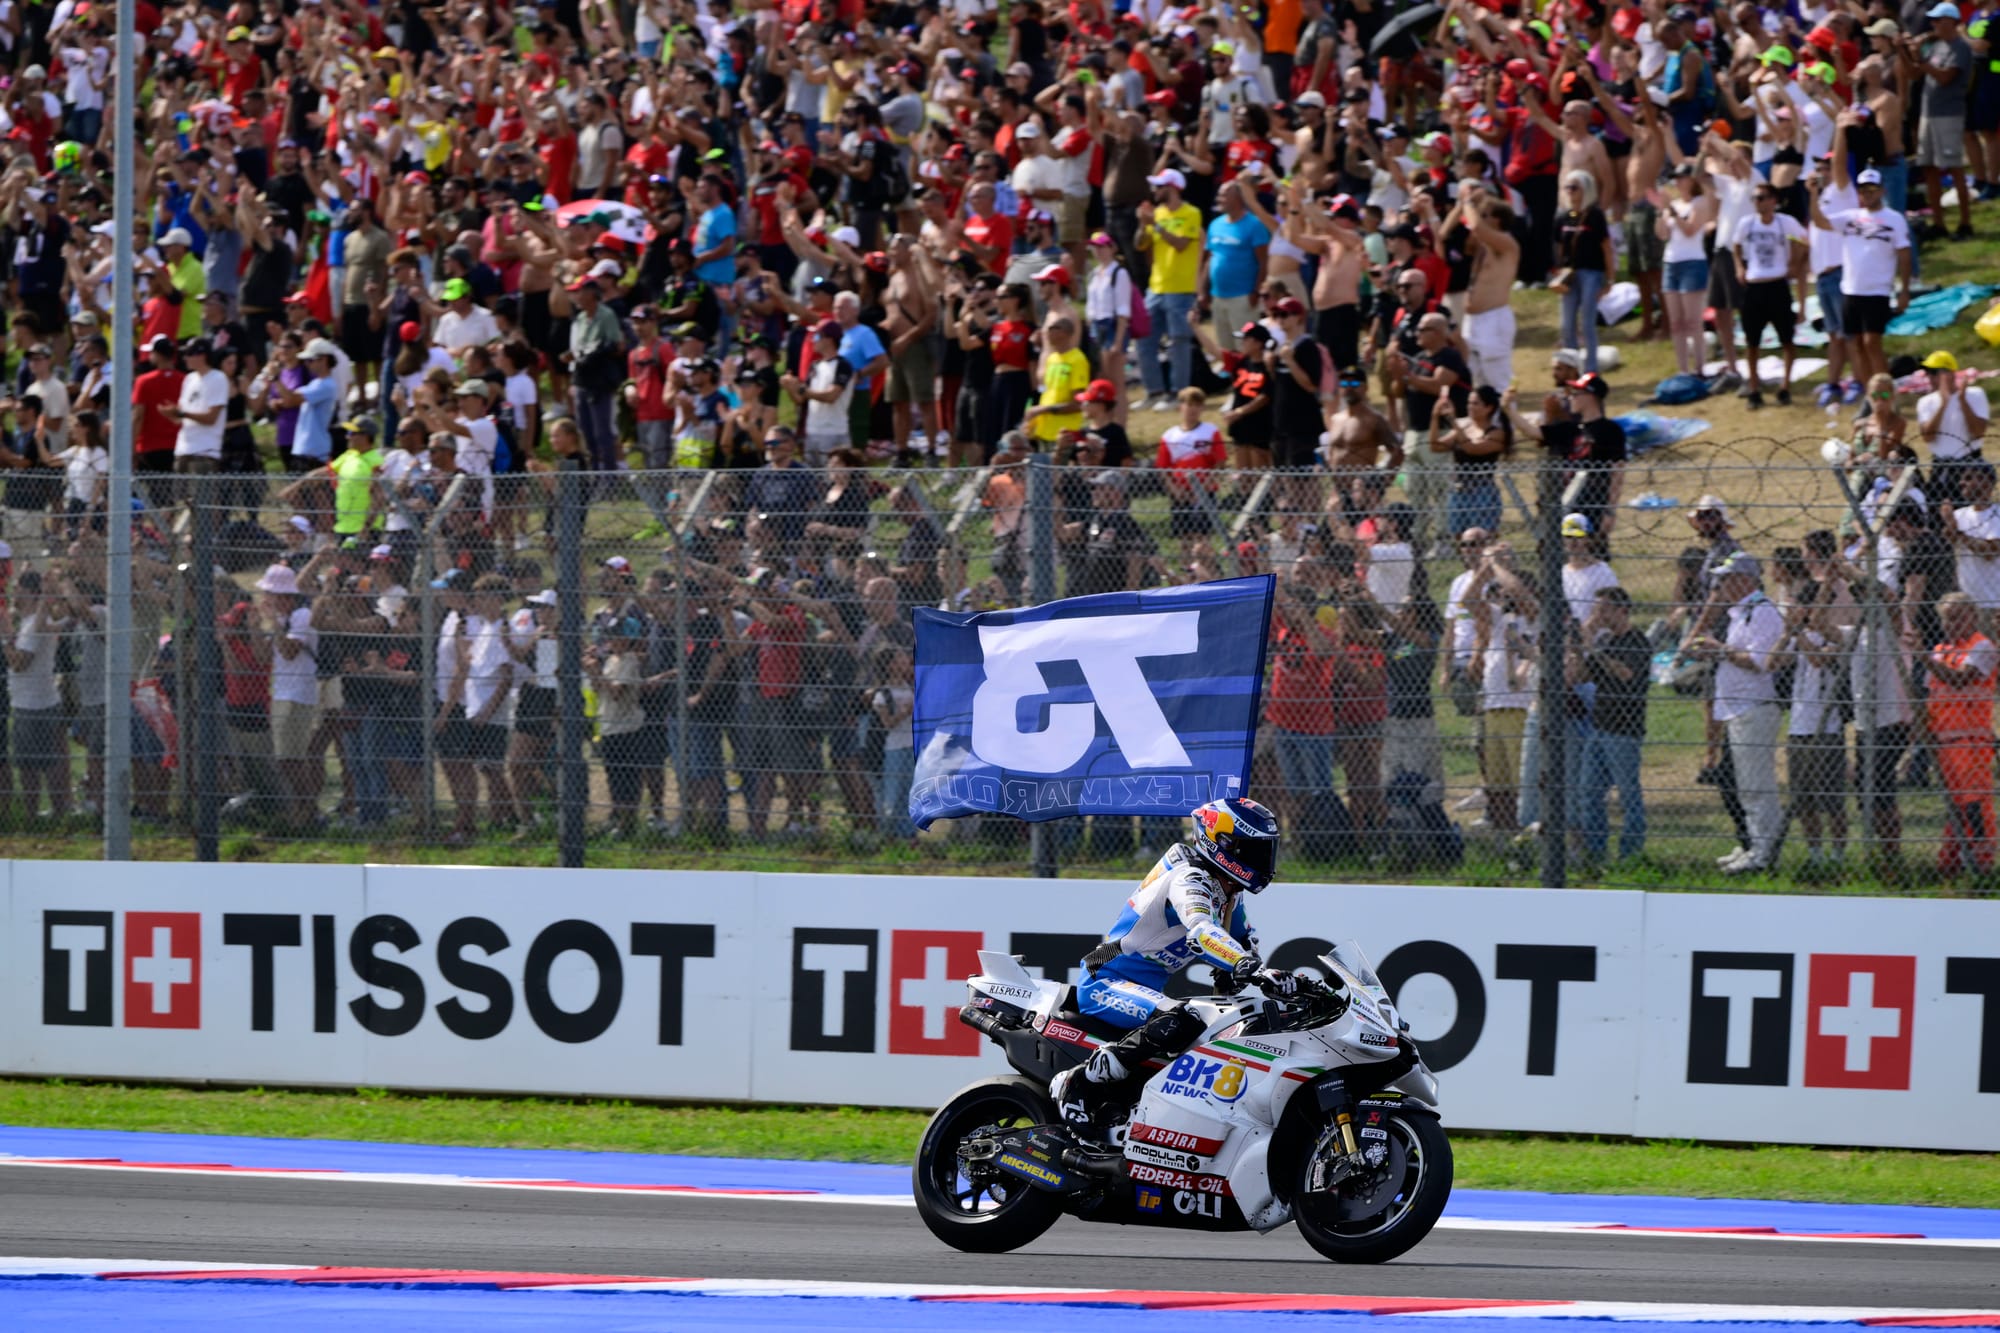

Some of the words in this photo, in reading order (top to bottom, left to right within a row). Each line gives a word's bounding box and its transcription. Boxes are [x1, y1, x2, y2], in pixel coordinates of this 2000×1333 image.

[1200, 834, 1218, 852] SHOEI
[1215, 852, 1235, 871] Red
[1233, 863, 1254, 881] Bull
[222, 912, 716, 1046] TISSOT
[1362, 1033, 1388, 1043] BOLD
[1244, 1040, 1287, 1056] DUCATI
[1166, 1054, 1246, 1100] BK8
[1160, 1081, 1209, 1099] NEWS
[1147, 1128, 1199, 1149] ASPIRA
[1132, 1145, 1185, 1163] MODULA
[1148, 1157, 1163, 1165] CASE
[1164, 1160, 1185, 1168] SYSTEM
[1000, 1154, 1062, 1185] MICHELIN
[1129, 1164, 1193, 1190] FEDERAL
[1198, 1177, 1224, 1194] OIL
